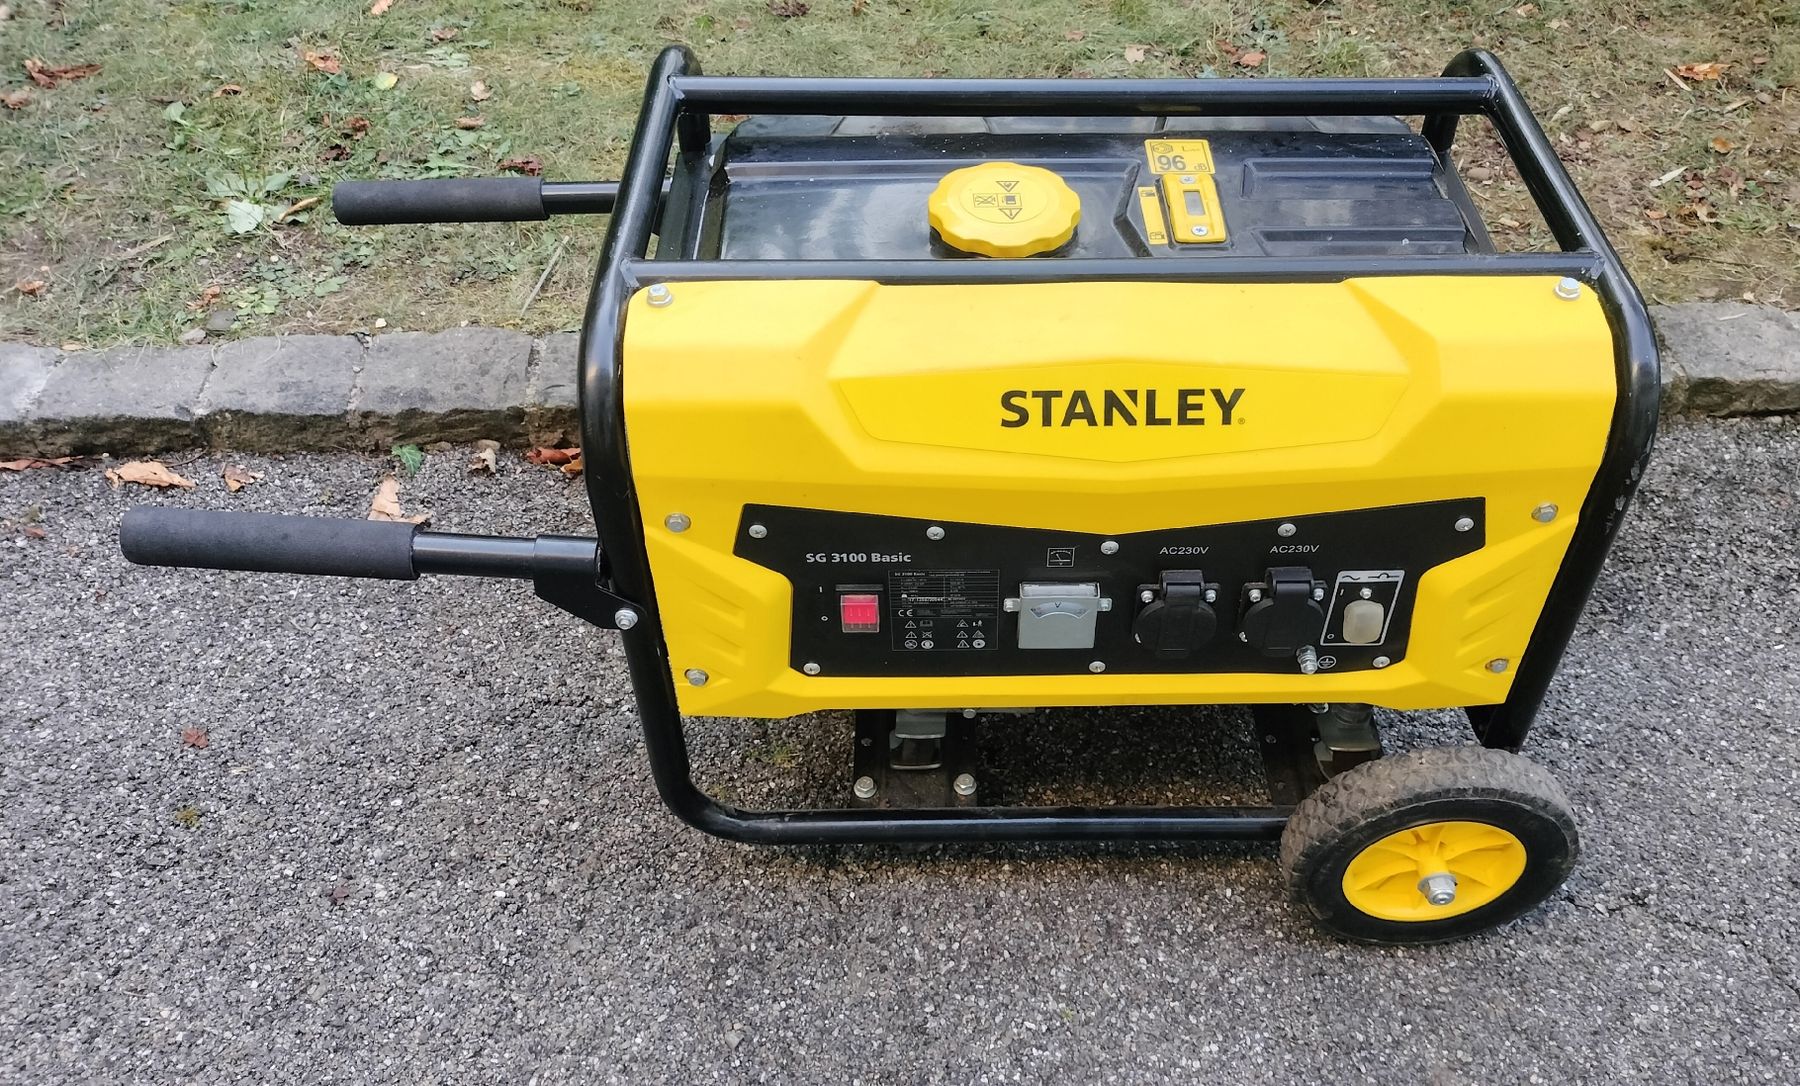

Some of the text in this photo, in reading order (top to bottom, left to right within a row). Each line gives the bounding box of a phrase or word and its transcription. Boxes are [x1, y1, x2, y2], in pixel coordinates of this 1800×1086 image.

[1157, 154, 1187, 171] 96
[1194, 162, 1208, 171] dB
[1000, 388, 1246, 428] STANLEY
[1159, 546, 1210, 555] AC230V
[1269, 544, 1321, 554] AC230V
[805, 551, 912, 563] SG 3100 Basic
